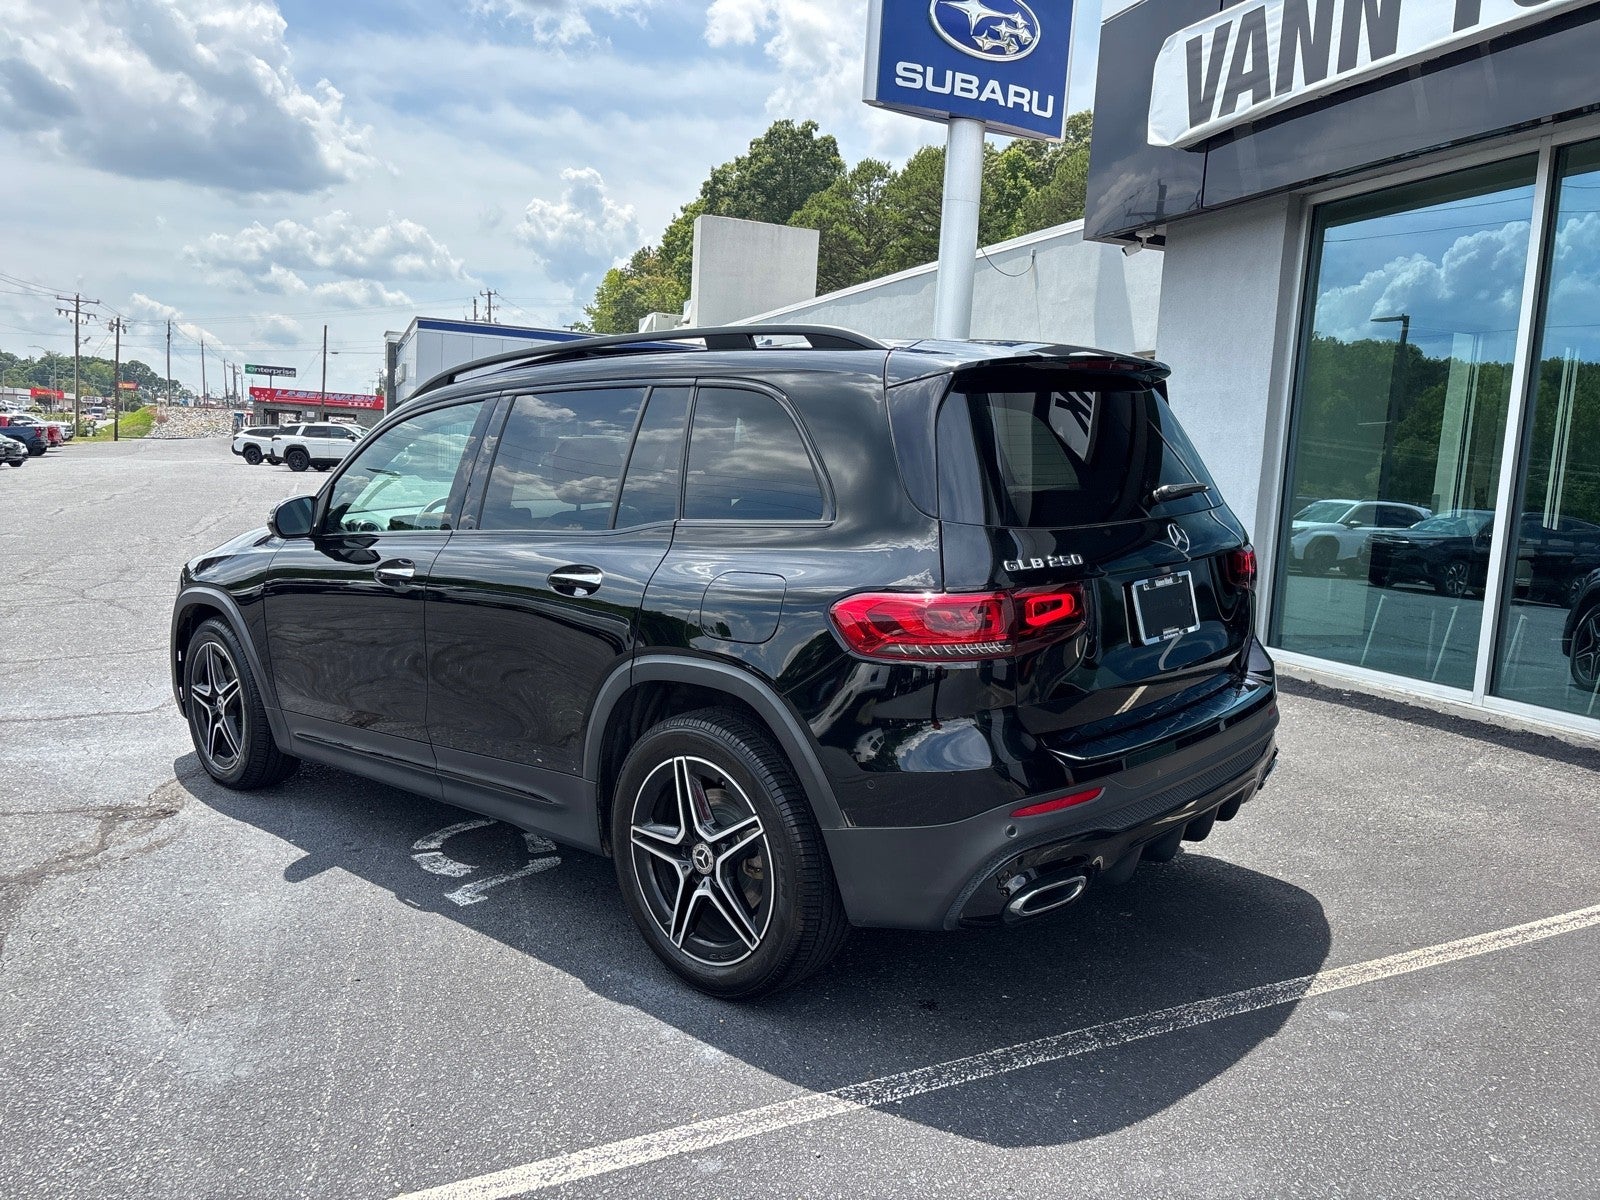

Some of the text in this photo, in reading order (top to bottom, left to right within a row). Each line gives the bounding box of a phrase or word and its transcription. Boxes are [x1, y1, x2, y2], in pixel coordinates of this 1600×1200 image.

[1186, 0, 1401, 129] VANN
[895, 61, 1054, 118] SUBARU
[247, 366, 295, 375] enterprise
[1003, 553, 1084, 571] GLB 250
